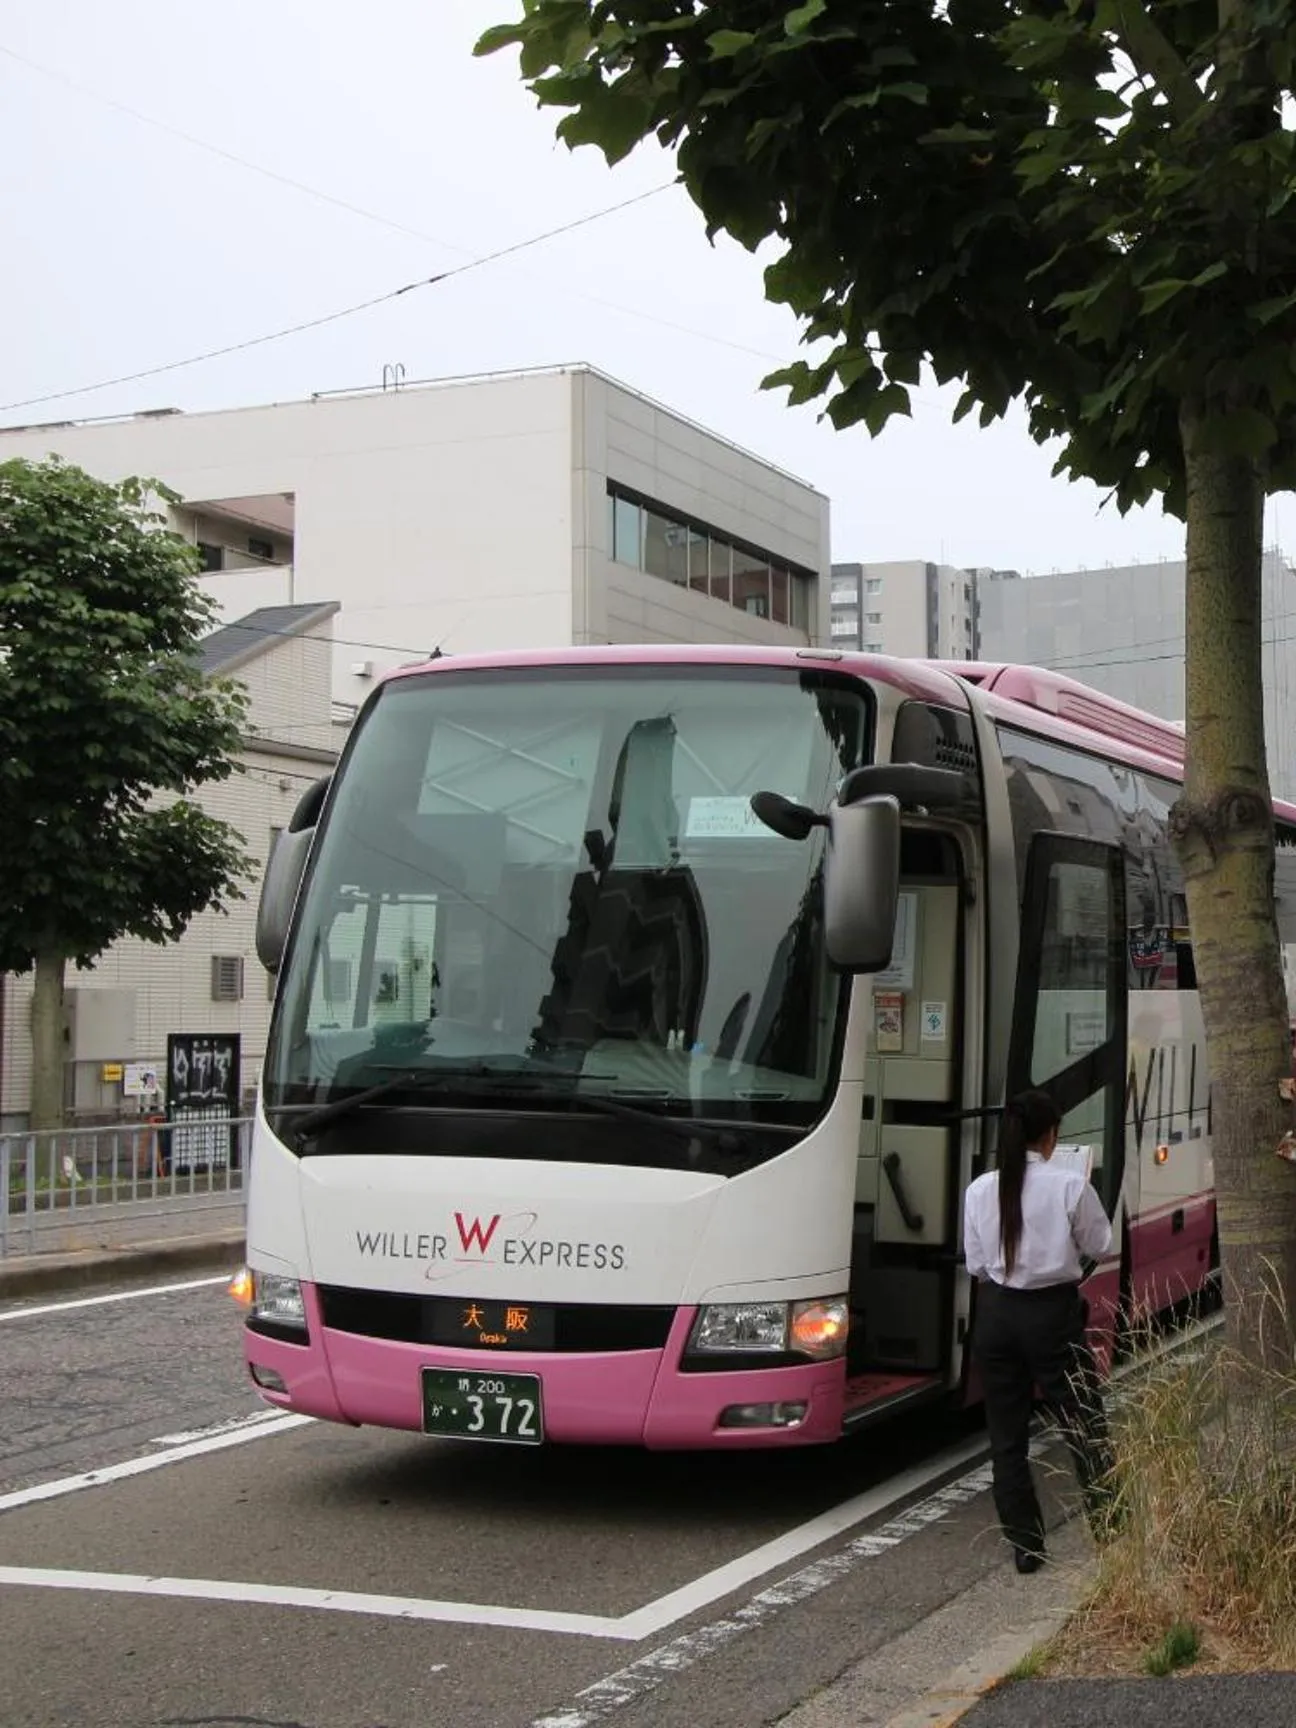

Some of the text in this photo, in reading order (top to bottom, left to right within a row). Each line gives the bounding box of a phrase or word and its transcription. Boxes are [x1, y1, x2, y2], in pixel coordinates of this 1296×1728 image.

[356, 1211, 625, 1270] WILLER W EXPRESS
[463, 1303, 529, 1332] 大阪
[476, 1380, 506, 1394] 200
[466, 1394, 537, 1436] 372
